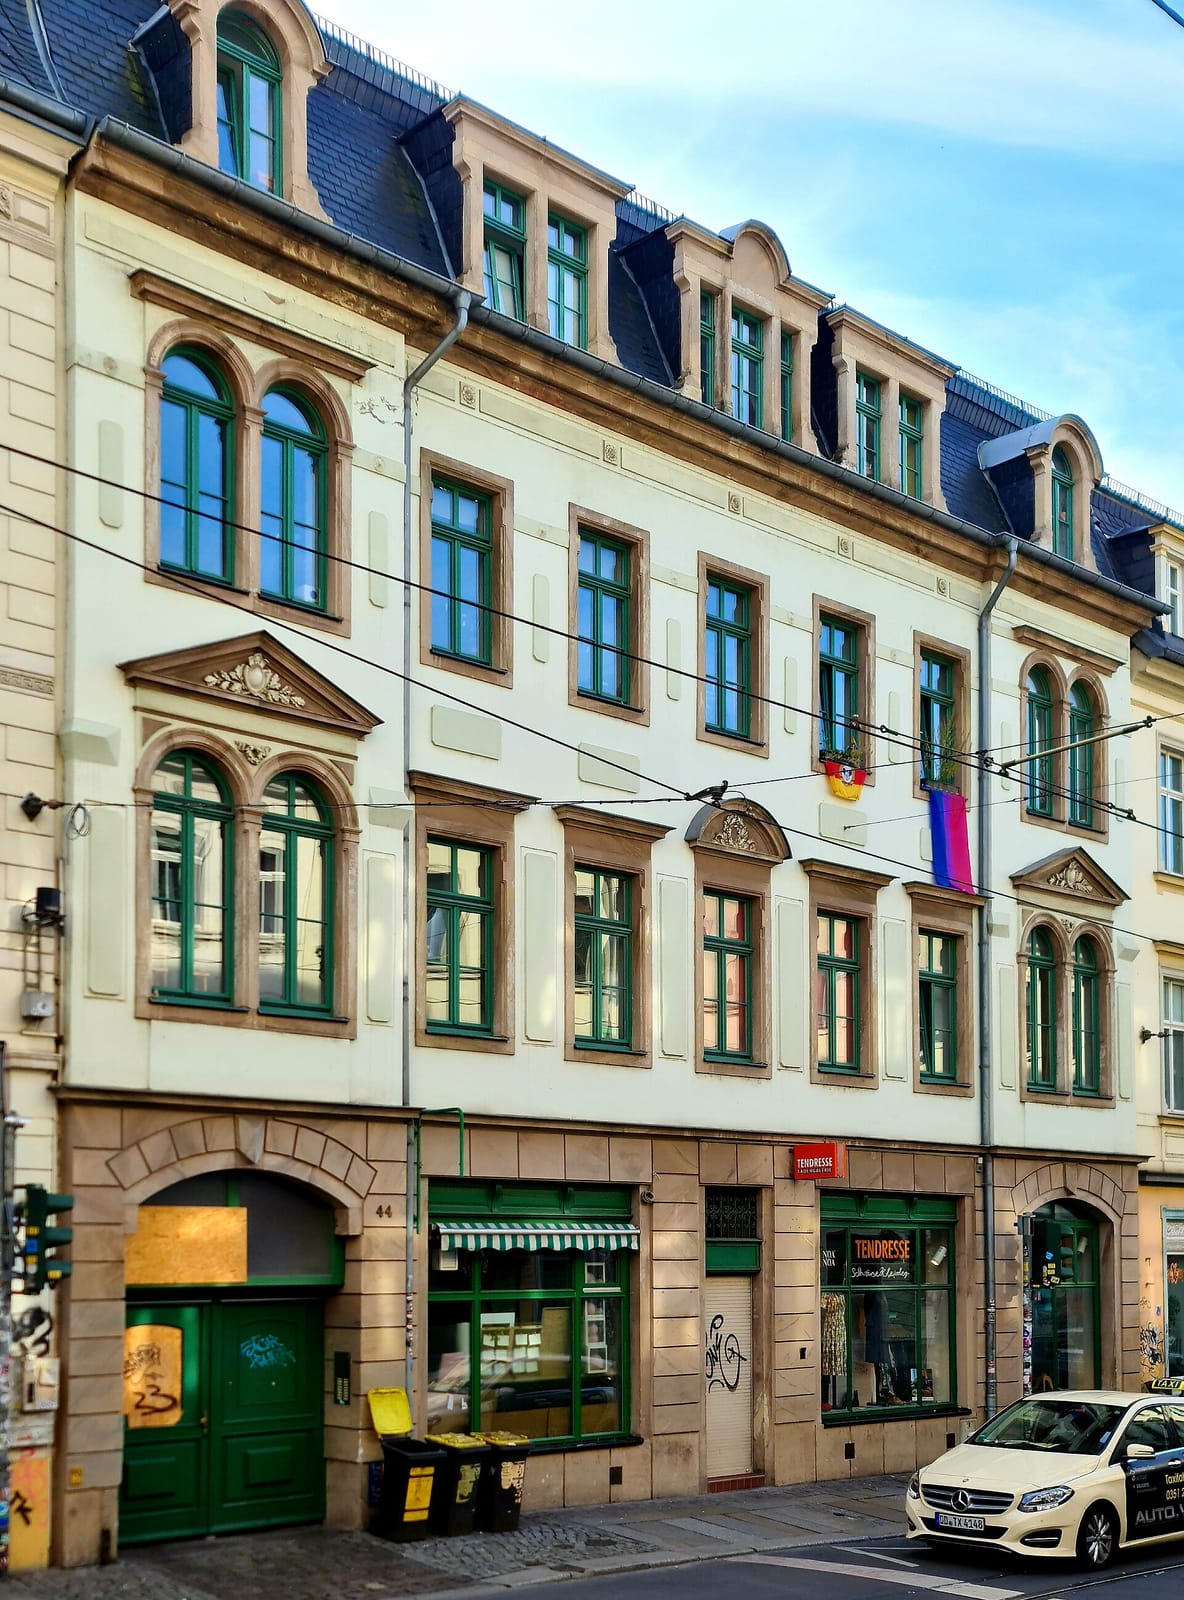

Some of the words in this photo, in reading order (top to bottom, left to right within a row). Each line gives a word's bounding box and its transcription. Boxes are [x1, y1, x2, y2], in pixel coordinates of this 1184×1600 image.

[797, 1157, 833, 1168] TENDRESSE
[375, 1204, 393, 1218] 44
[855, 1239, 910, 1259] TENDRESSE
[1156, 1379, 1179, 1389] TAXI
[1165, 1488, 1180, 1500] 0351
